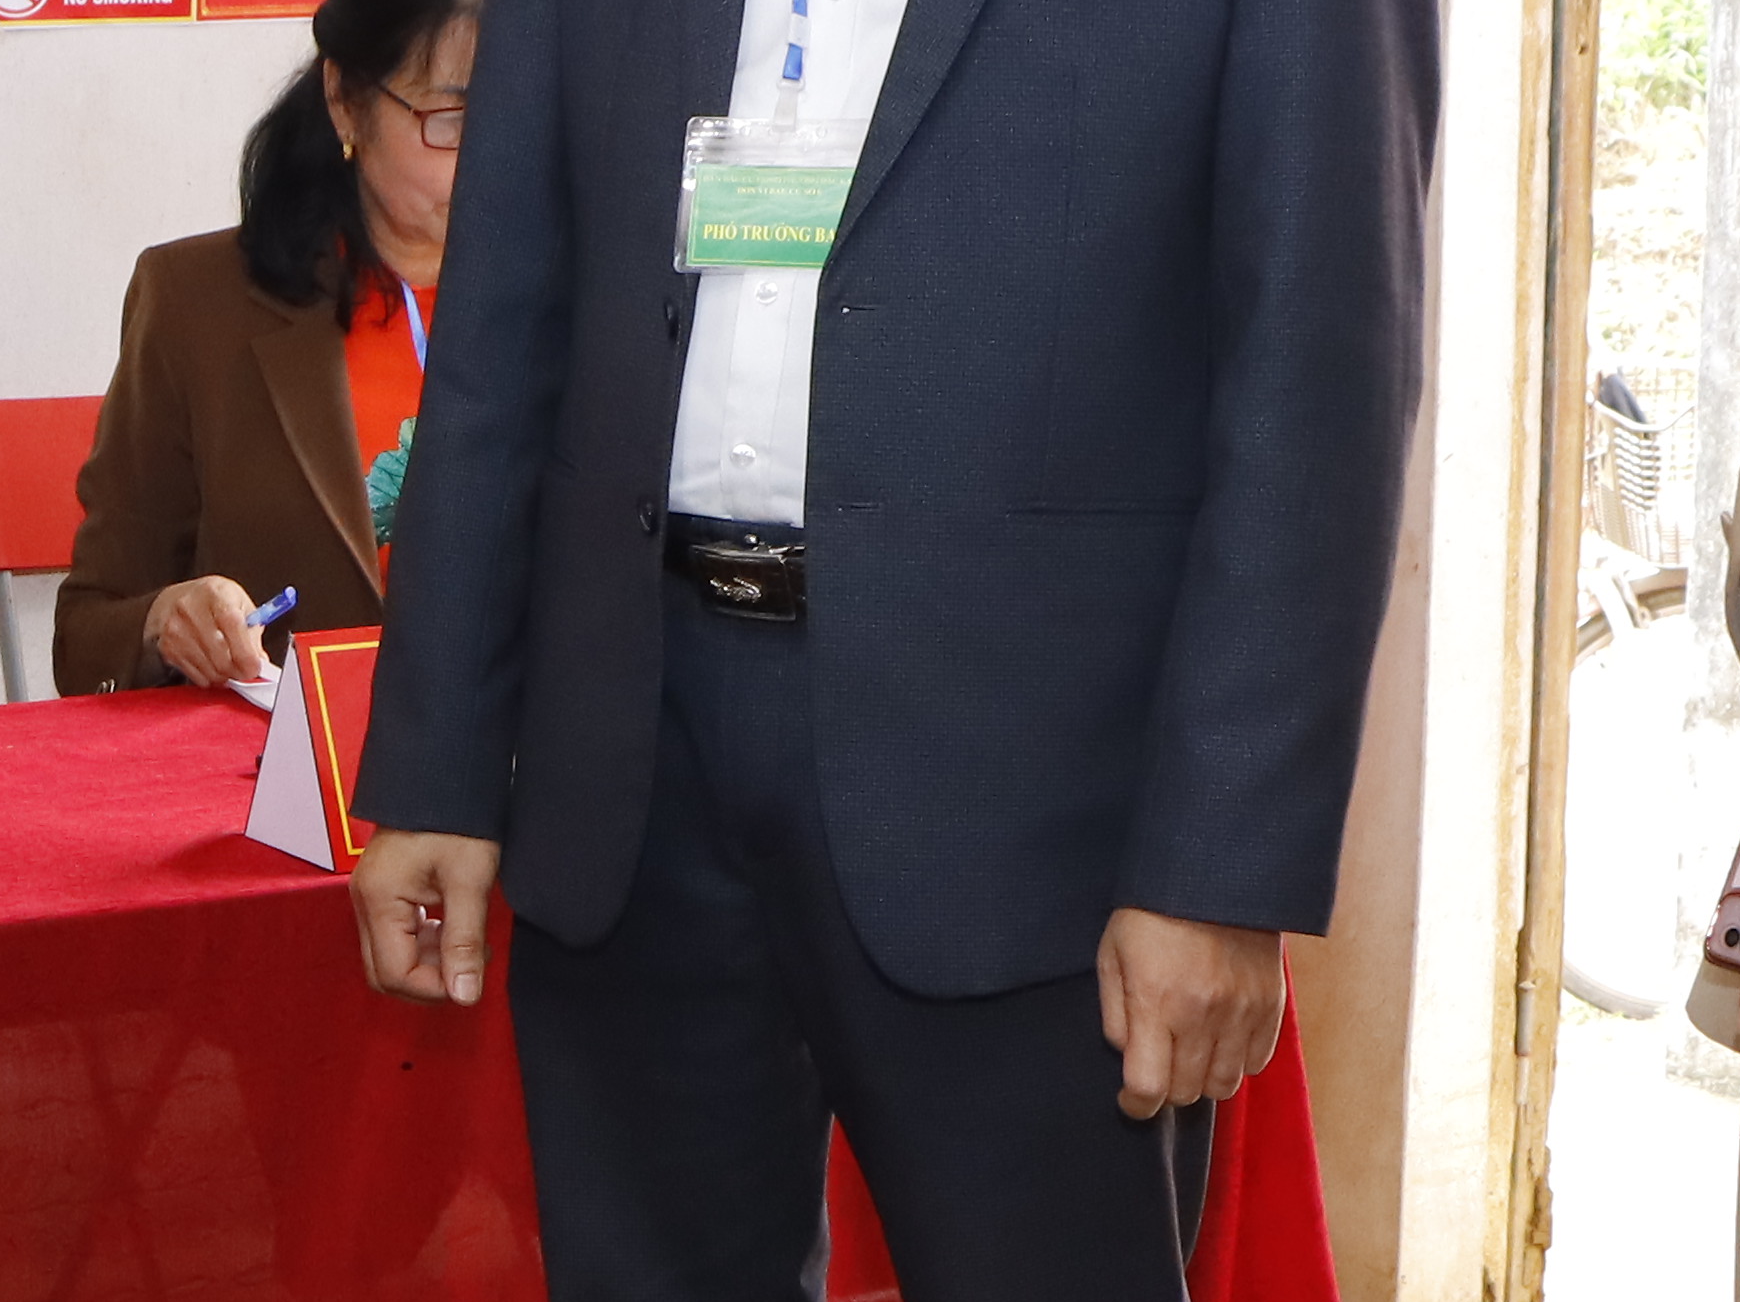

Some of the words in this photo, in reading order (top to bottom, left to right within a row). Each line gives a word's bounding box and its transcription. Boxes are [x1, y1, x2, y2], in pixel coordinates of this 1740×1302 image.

[703, 221, 737, 240] PHÓ
[743, 223, 810, 241] TRƯỞNG
[815, 227, 838, 243] BA
